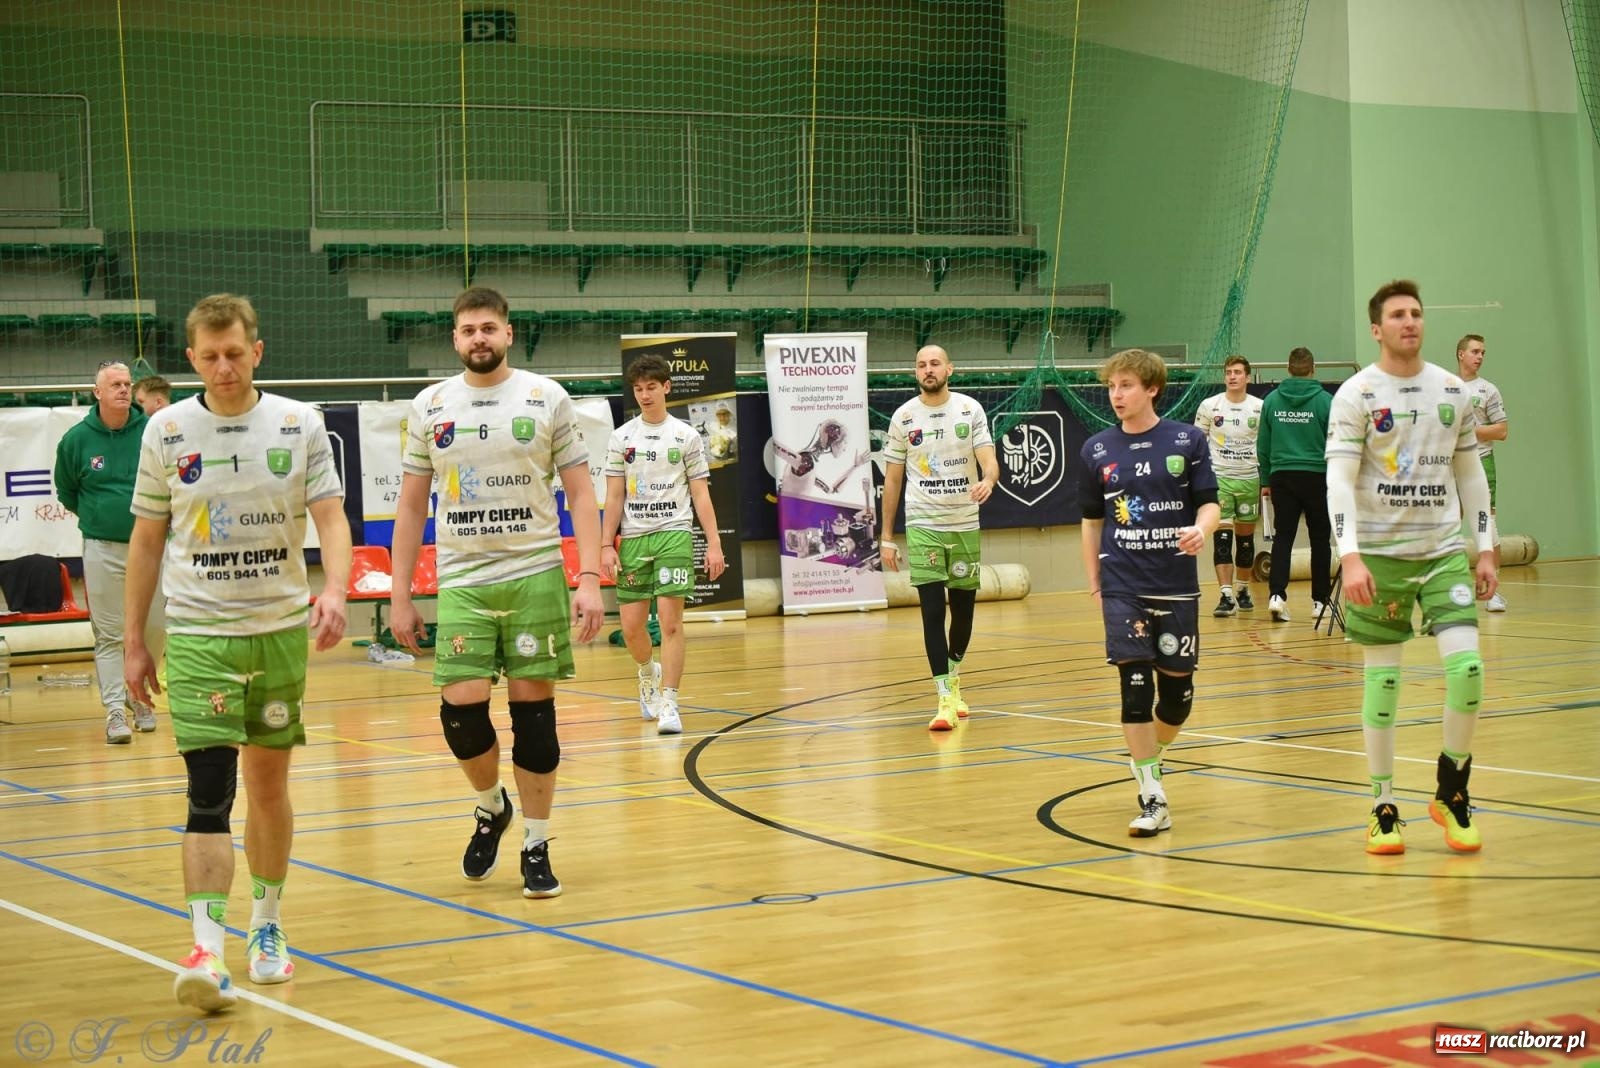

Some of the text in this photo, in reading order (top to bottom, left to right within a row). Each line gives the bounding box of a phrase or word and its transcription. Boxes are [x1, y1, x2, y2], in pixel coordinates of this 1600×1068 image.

[780, 346, 856, 364] PIVEXIN
[667, 360, 709, 372] YPUŁA
[782, 365, 856, 376] TECHNOLOGY
[778, 384, 848, 393] Nie zwalniamy tempa
[790, 401, 864, 412] nowymi technologiami
[1232, 418, 1240, 426] 10
[1410, 409, 1417, 424] 7
[479, 424, 488, 440] 6
[934, 429, 944, 440] 77
[646, 451, 657, 461] 99
[944, 457, 968, 467] GUARD
[1418, 455, 1452, 466] GUARD
[230, 454, 239, 473] 1
[1135, 461, 1151, 477] 24
[5, 469, 51, 497] E
[375, 475, 392, 486] tel.
[486, 474, 531, 487] GUARD
[1377, 483, 1417, 497] POMPY
[628, 501, 677, 511] POMPY CIEPŁA
[1148, 501, 1184, 512] GUARD
[1390, 499, 1409, 507] 605
[1412, 499, 1431, 507] 944
[35, 504, 73, 521] KRA
[447, 507, 533, 524] POMPY CIEPŁA
[240, 512, 285, 526] GUARD
[457, 523, 527, 536] 605 944 146
[1114, 528, 1149, 540] POMPY
[1125, 542, 1143, 550] 605
[1145, 541, 1163, 549] 944
[192, 547, 288, 567] POMPY CIEPŁA
[207, 565, 280, 580] 605 944 146
[672, 568, 688, 585] 99
[793, 586, 854, 597] www.pivexin-tech.pl
[1180, 635, 1196, 657] 24
